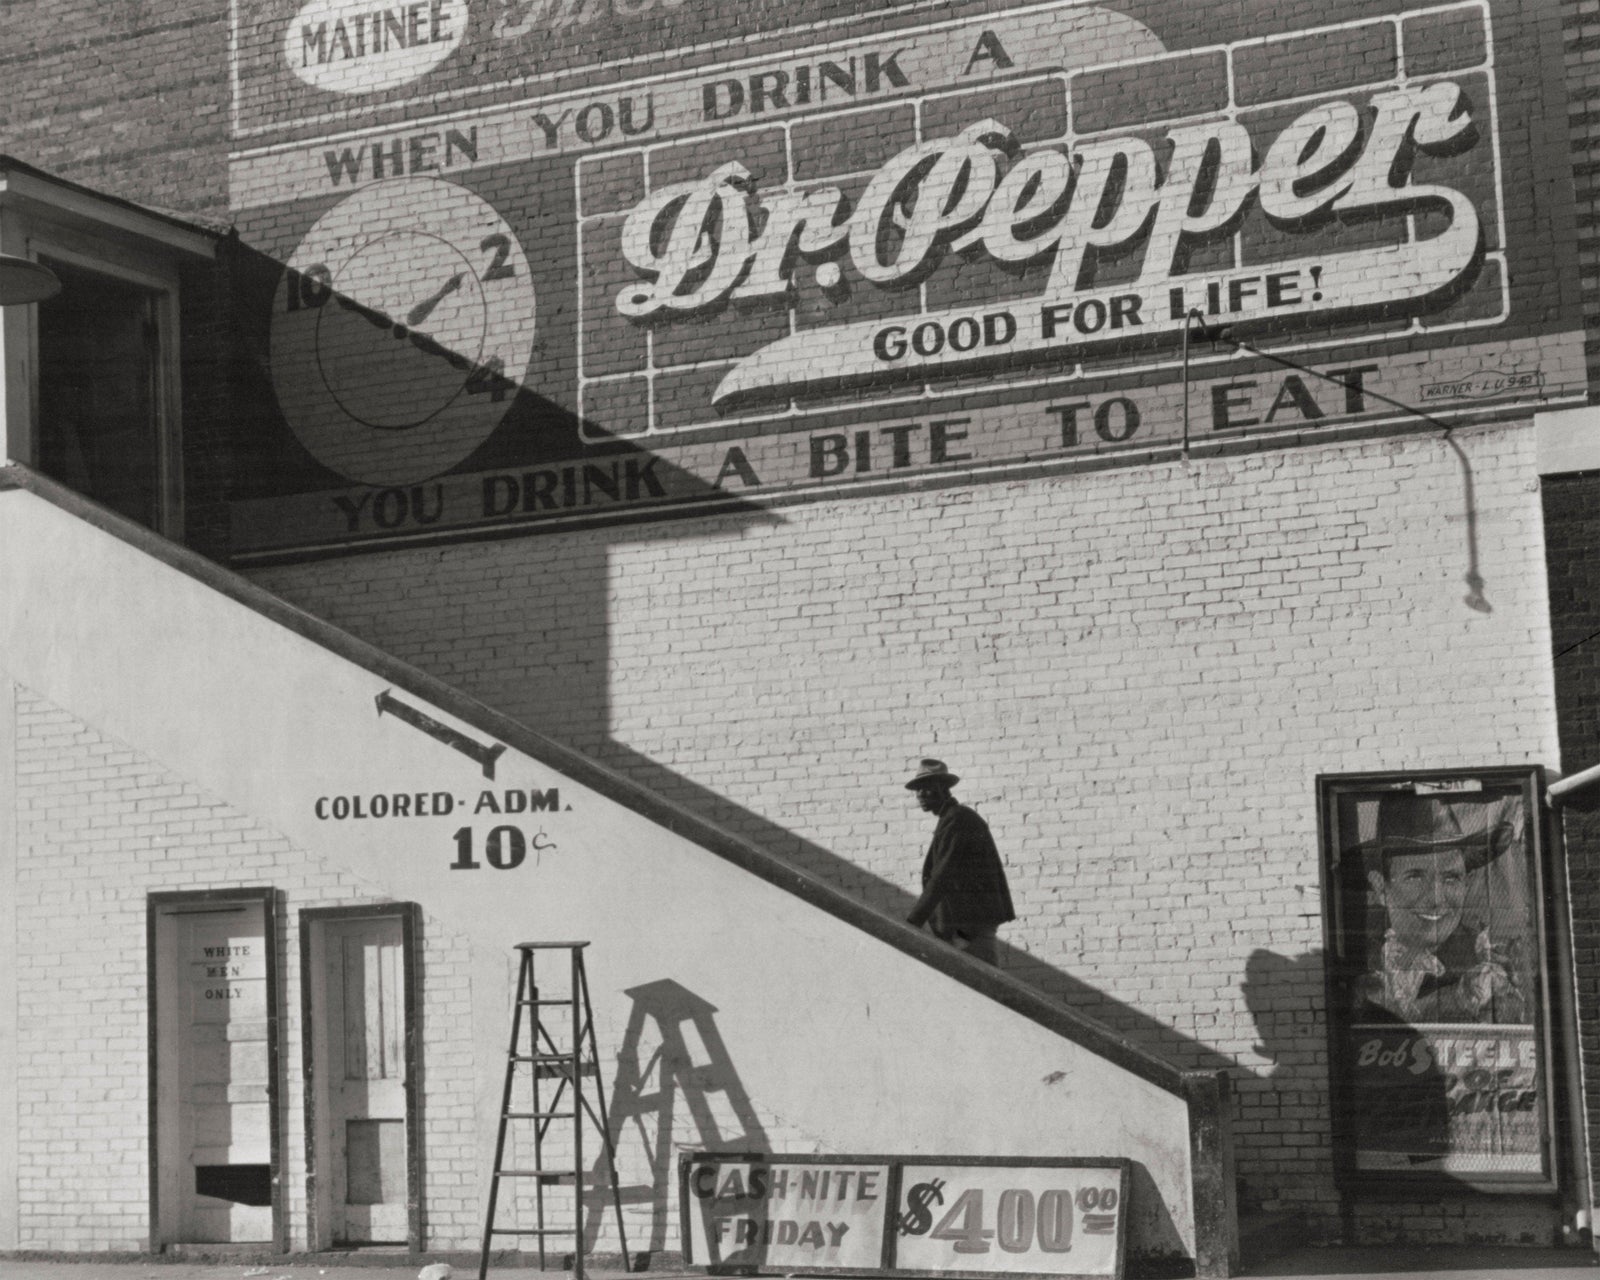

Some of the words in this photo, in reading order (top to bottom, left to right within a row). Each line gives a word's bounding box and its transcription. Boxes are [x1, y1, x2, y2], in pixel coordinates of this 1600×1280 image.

[302, 0, 453, 67] MATINEE
[325, 126, 478, 186] WHEN
[531, 93, 653, 149] YOU
[704, 50, 906, 121] DRINK
[967, 27, 1014, 83] A
[615, 160, 853, 318] Dr.
[848, 80, 1480, 305] Pepper
[480, 234, 516, 280] 2
[874, 311, 1017, 360] GOOD
[1041, 294, 1143, 338] FOR
[1169, 265, 1324, 321] LIFE!
[465, 356, 516, 402] 4
[1427, 382, 1472, 397] WARNER
[333, 483, 443, 532] YOU
[483, 455, 664, 518] DRINK
[713, 446, 760, 489] A
[808, 417, 972, 479] BITE
[1046, 396, 1140, 447] TO
[1211, 364, 1379, 430] EAT
[203, 946, 250, 958] WHITE
[207, 966, 240, 977] MEN
[205, 988, 242, 999] ONLY
[1358, 1038, 1410, 1067] Bob
[1407, 1037, 1537, 1075] STEELE
[690, 1168, 880, 1202] CASH-NITE
[716, 1217, 850, 1249] FRIDAY
